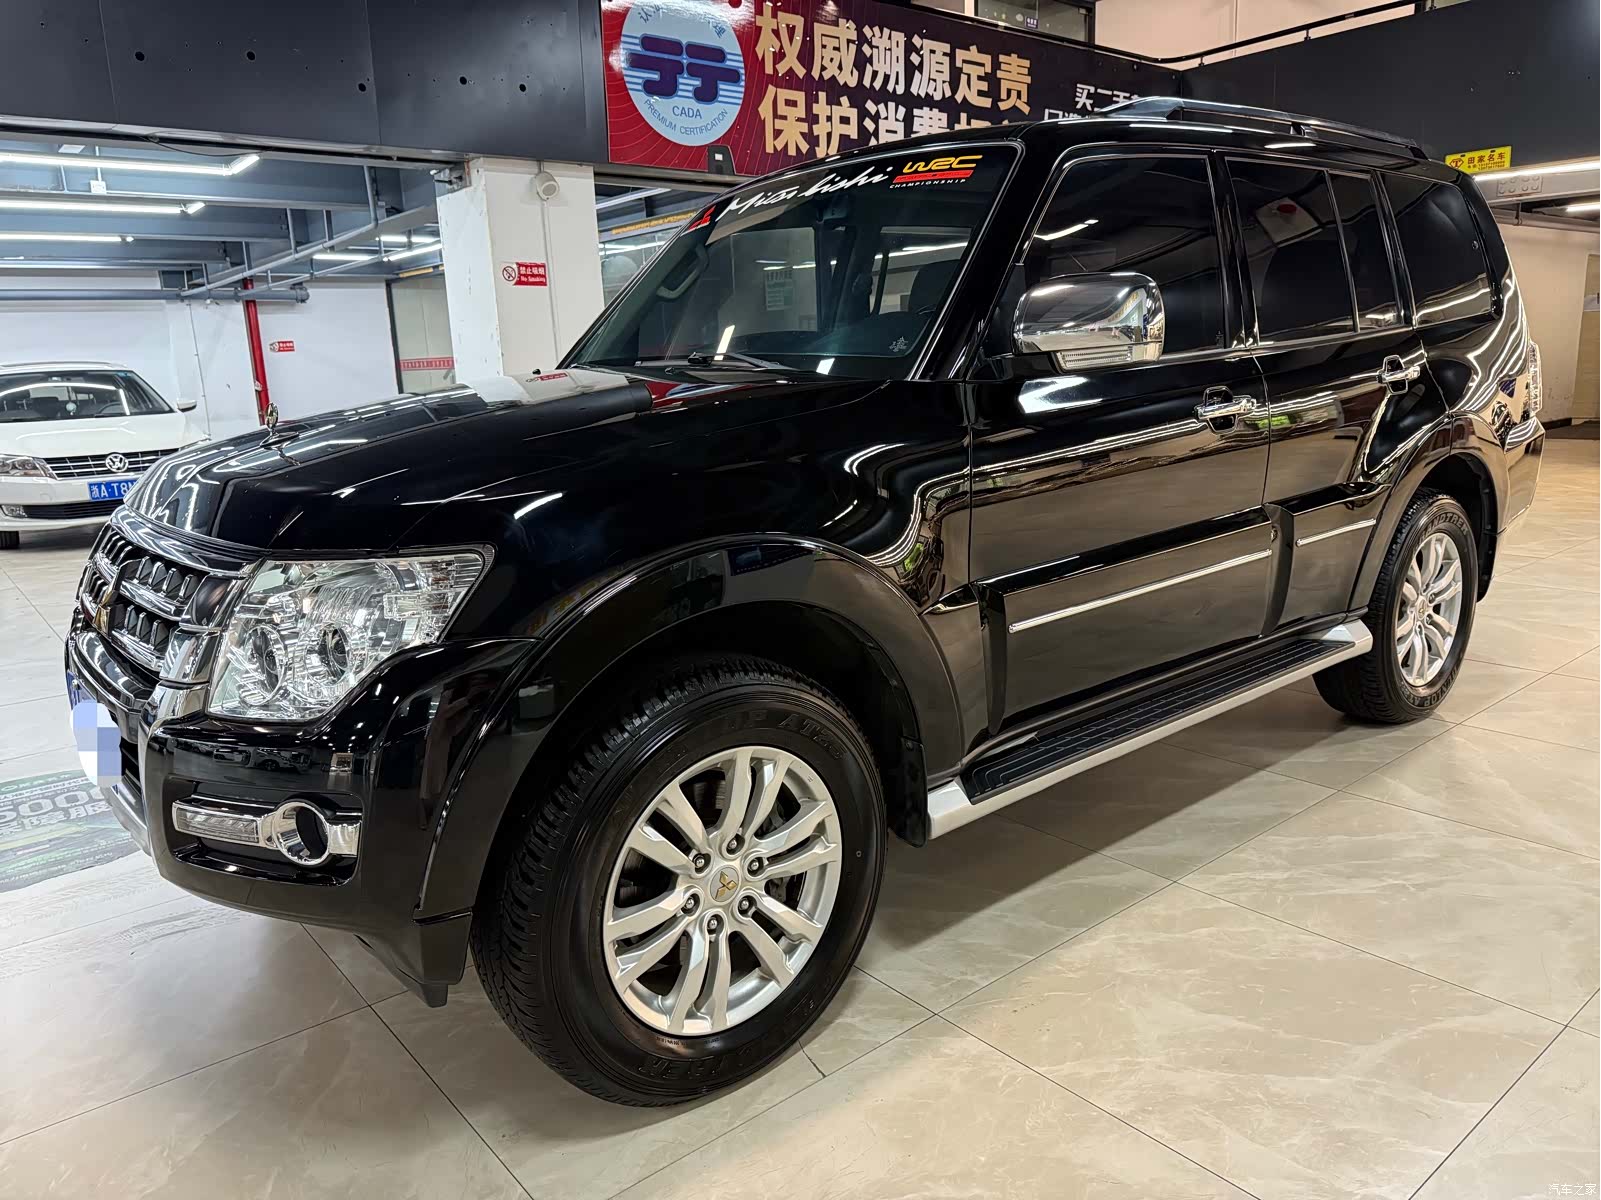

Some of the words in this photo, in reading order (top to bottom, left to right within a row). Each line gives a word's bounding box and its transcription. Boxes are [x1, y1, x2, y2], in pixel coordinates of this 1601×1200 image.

[755, 8, 1032, 116] 权威溯源定责
[1075, 83, 1140, 112] 买二手
[643, 98, 677, 132] PREMIUM
[679, 108, 729, 136] CERTIFICATION
[672, 105, 703, 119] CADA
[902, 154, 983, 174] WRC
[1467, 152, 1506, 164] 田家名车
[889, 178, 966, 189] CHAMPIONSHIP
